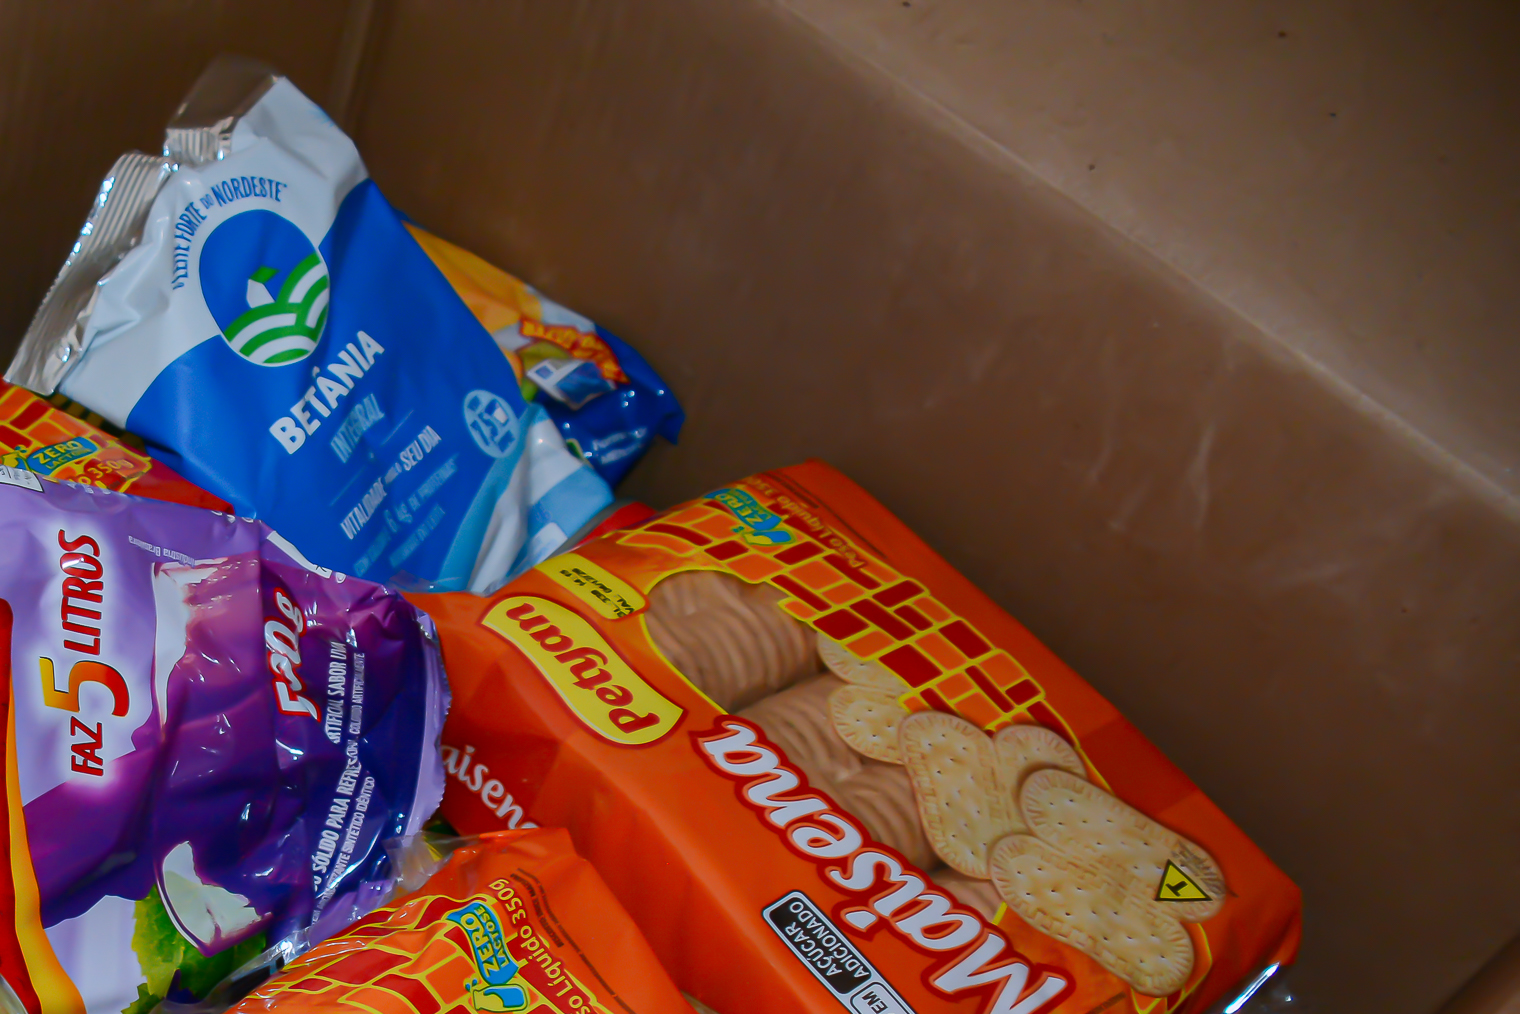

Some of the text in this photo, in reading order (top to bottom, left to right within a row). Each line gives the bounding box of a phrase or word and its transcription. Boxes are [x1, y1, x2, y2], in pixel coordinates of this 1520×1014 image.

[269, 330, 385, 455] BETÂNIA
[32, 438, 82, 465] ZERO
[717, 492, 760, 523] ZERO
[39, 528, 130, 778] FAZ 5 LITROS
[328, 660, 348, 699] SABOR
[506, 601, 661, 735] Petyan
[328, 795, 351, 829] PARA
[356, 776, 375, 815] IDÊNTICO
[491, 879, 526, 924] 350g
[459, 912, 501, 975] ZERO
[474, 904, 510, 967] LACTOSE
[518, 925, 577, 996] Líquido
[785, 921, 842, 976] AÇÚCAR
[789, 901, 869, 978] ADICIONADO
[862, 991, 888, 1014] EM
